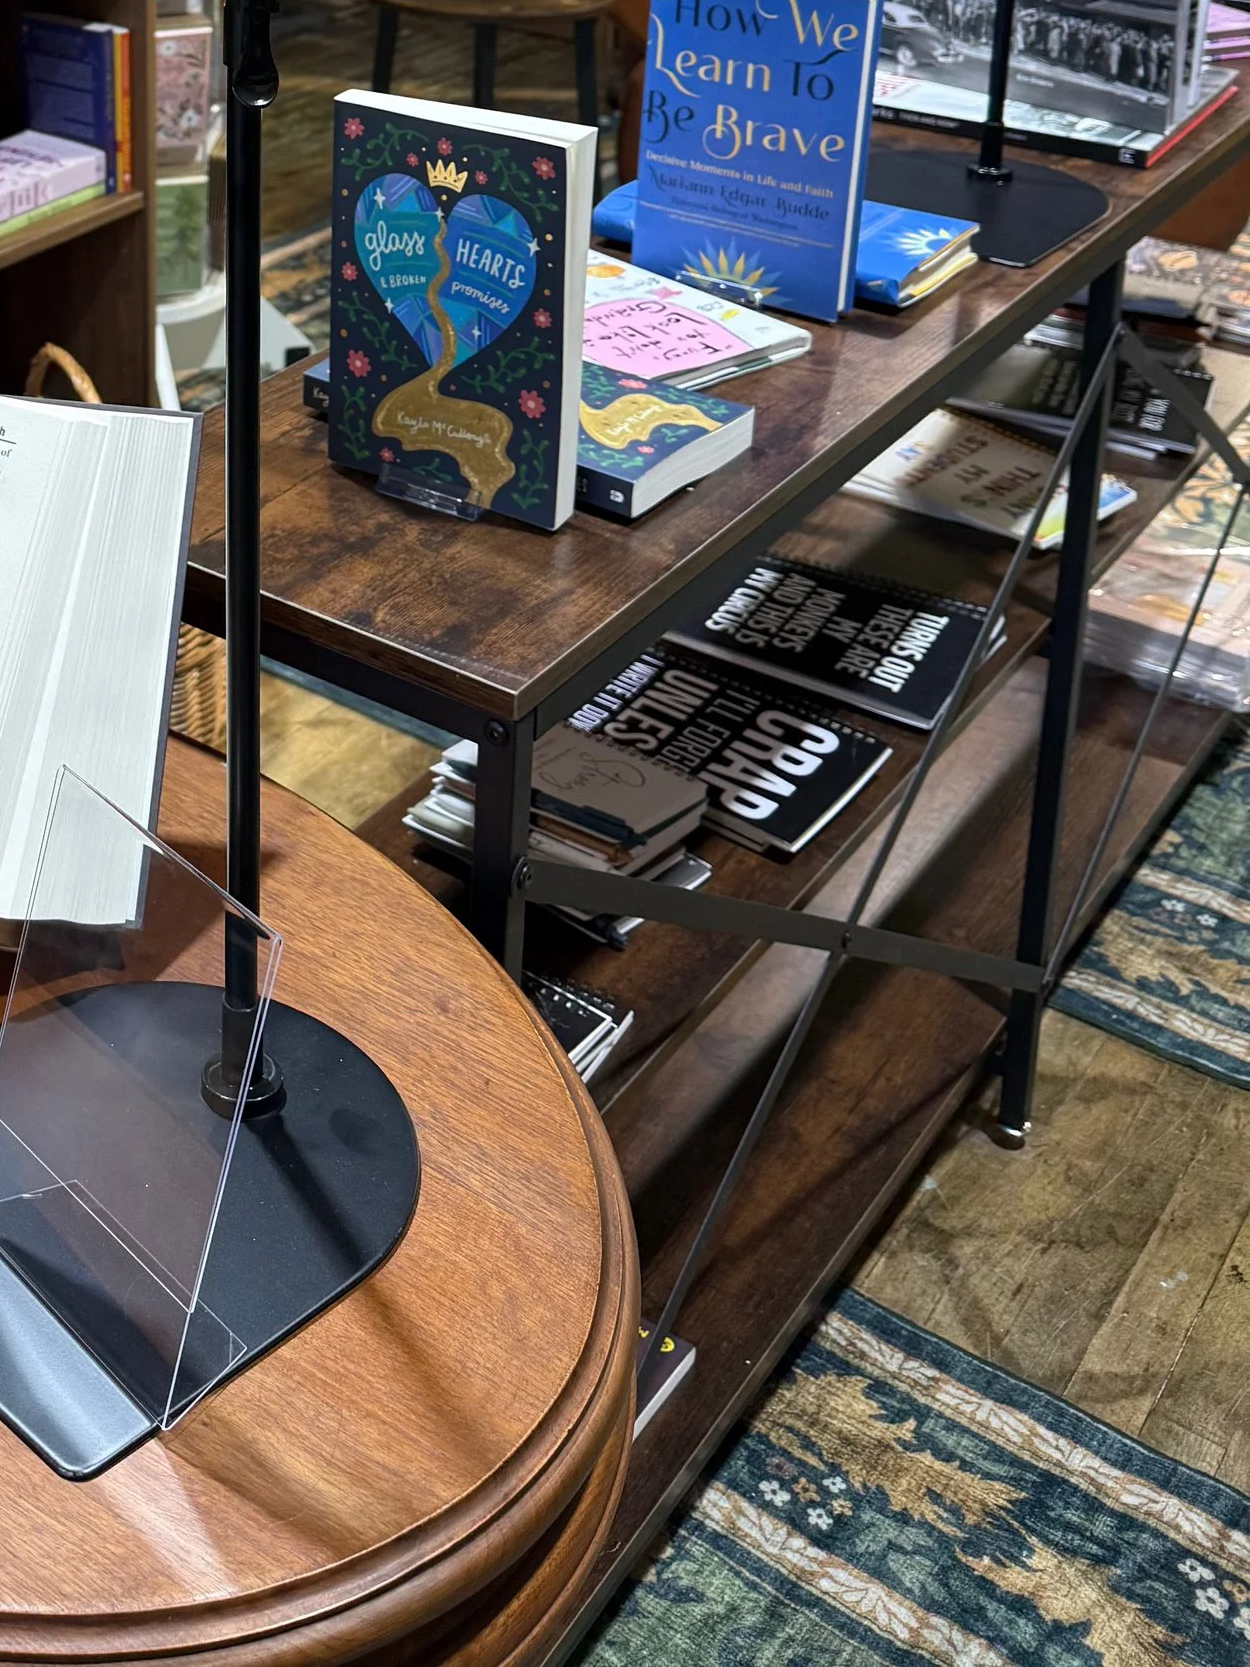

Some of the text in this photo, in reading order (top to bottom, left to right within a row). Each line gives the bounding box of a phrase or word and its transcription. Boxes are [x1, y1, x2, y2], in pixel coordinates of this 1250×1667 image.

[650, 13, 858, 101] Learn To
[643, 89, 696, 144] Be
[703, 104, 846, 162] Brave
[364, 220, 426, 271] glass
[456, 238, 525, 289] HEARTS
[389, 275, 426, 286] BROKEN
[452, 281, 510, 315] promises
[867, 610, 950, 694] TURNS OUT
[701, 710, 841, 821] CRAP
